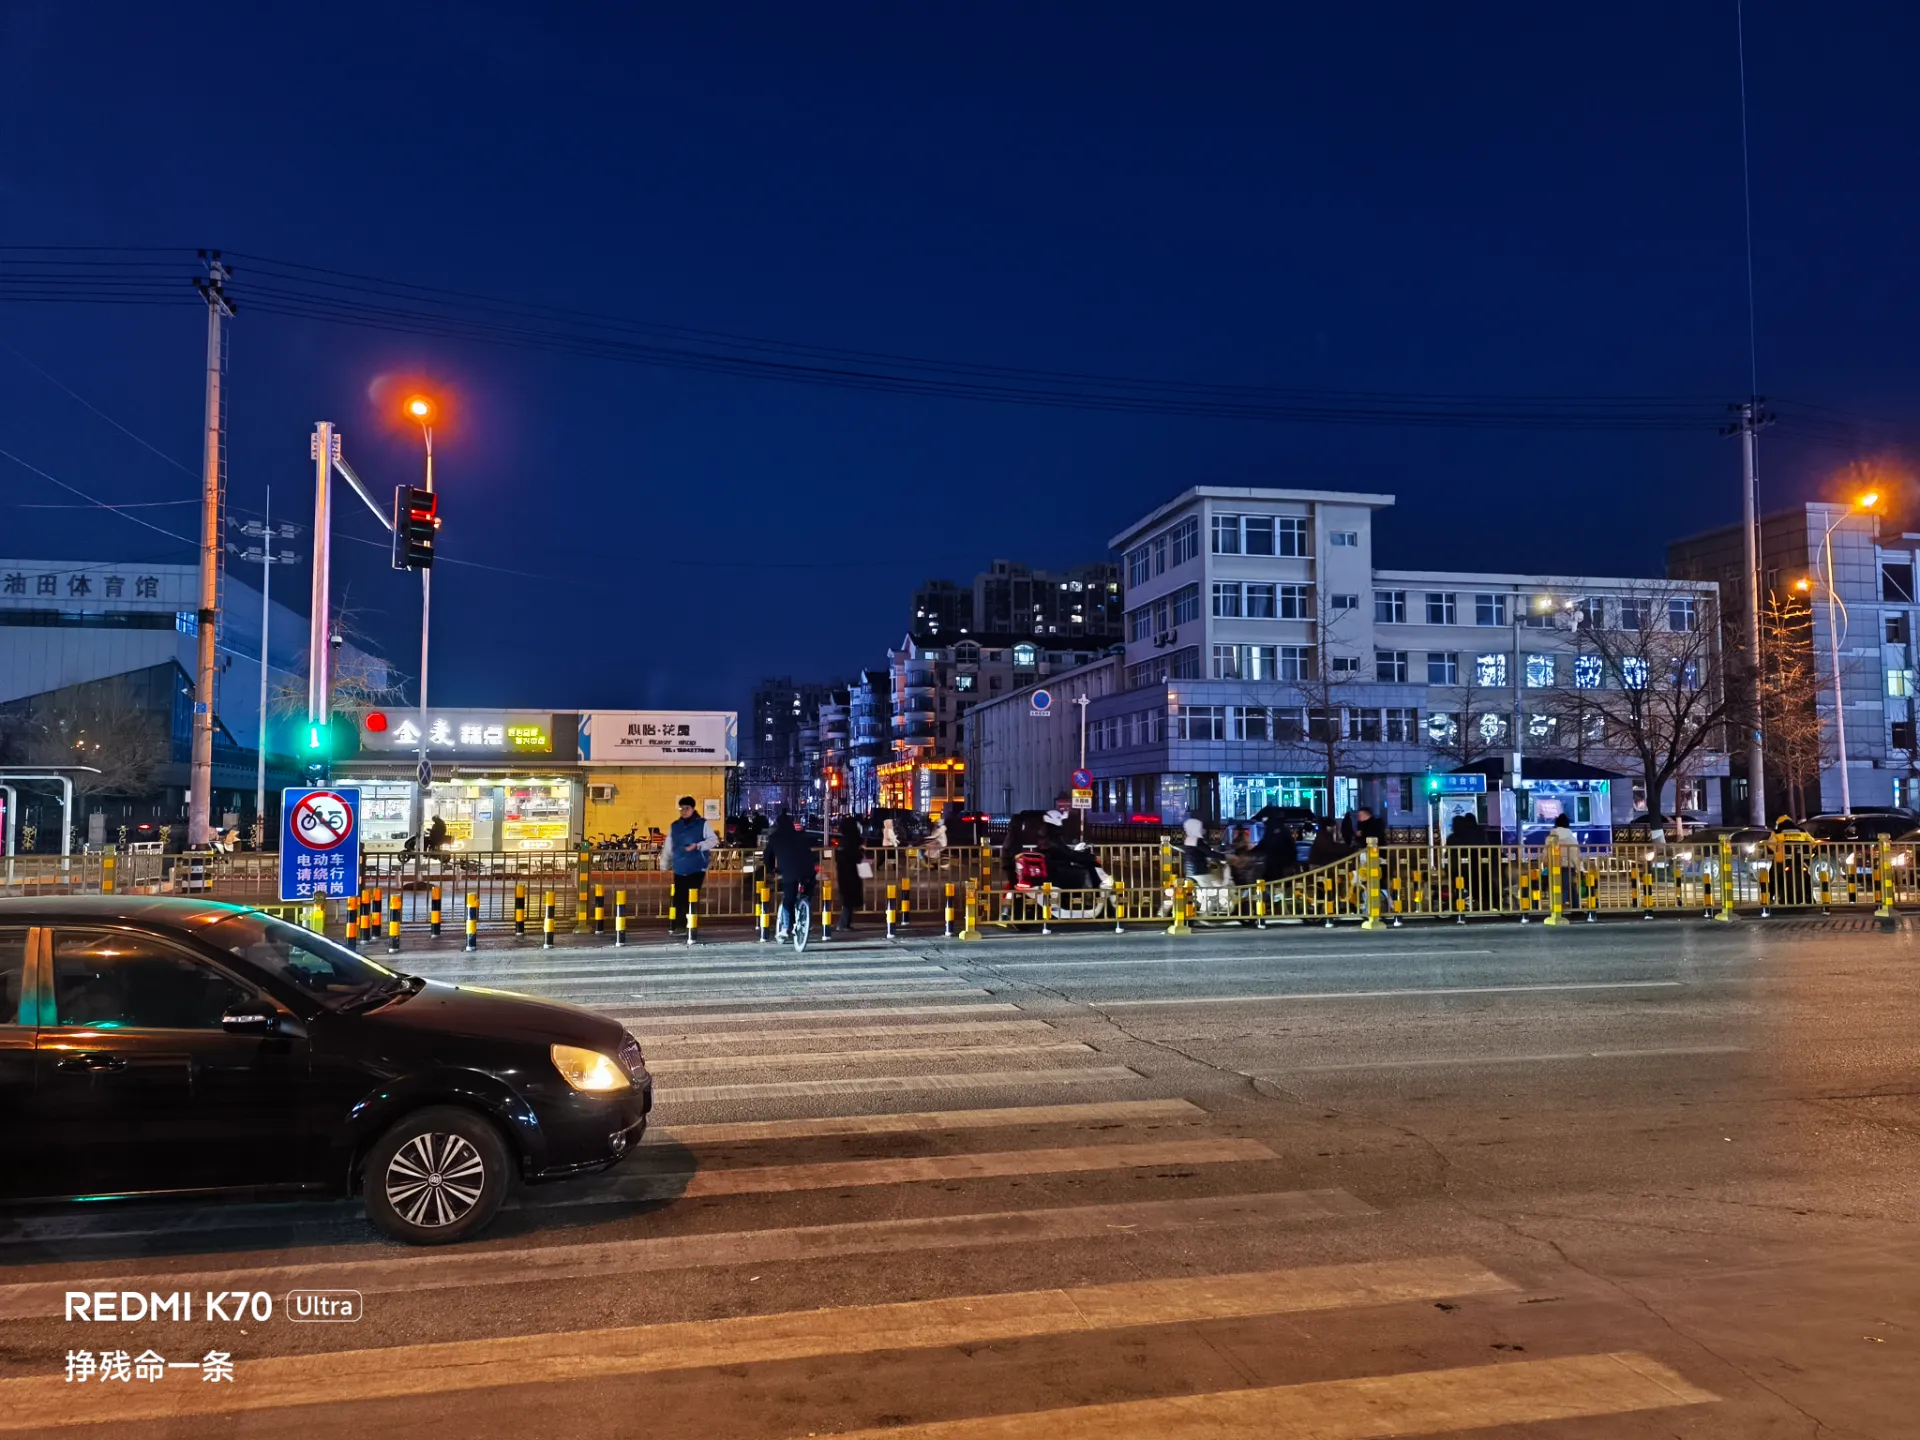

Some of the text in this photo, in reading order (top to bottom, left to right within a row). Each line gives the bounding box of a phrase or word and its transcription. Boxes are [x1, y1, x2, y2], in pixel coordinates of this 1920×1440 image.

[3, 572, 159, 599] 油田体育馆
[392, 718, 504, 747] 金麦糕点
[297, 853, 345, 867] 电动车
[296, 867, 345, 881] 请绕行
[296, 881, 344, 896] 交通岗
